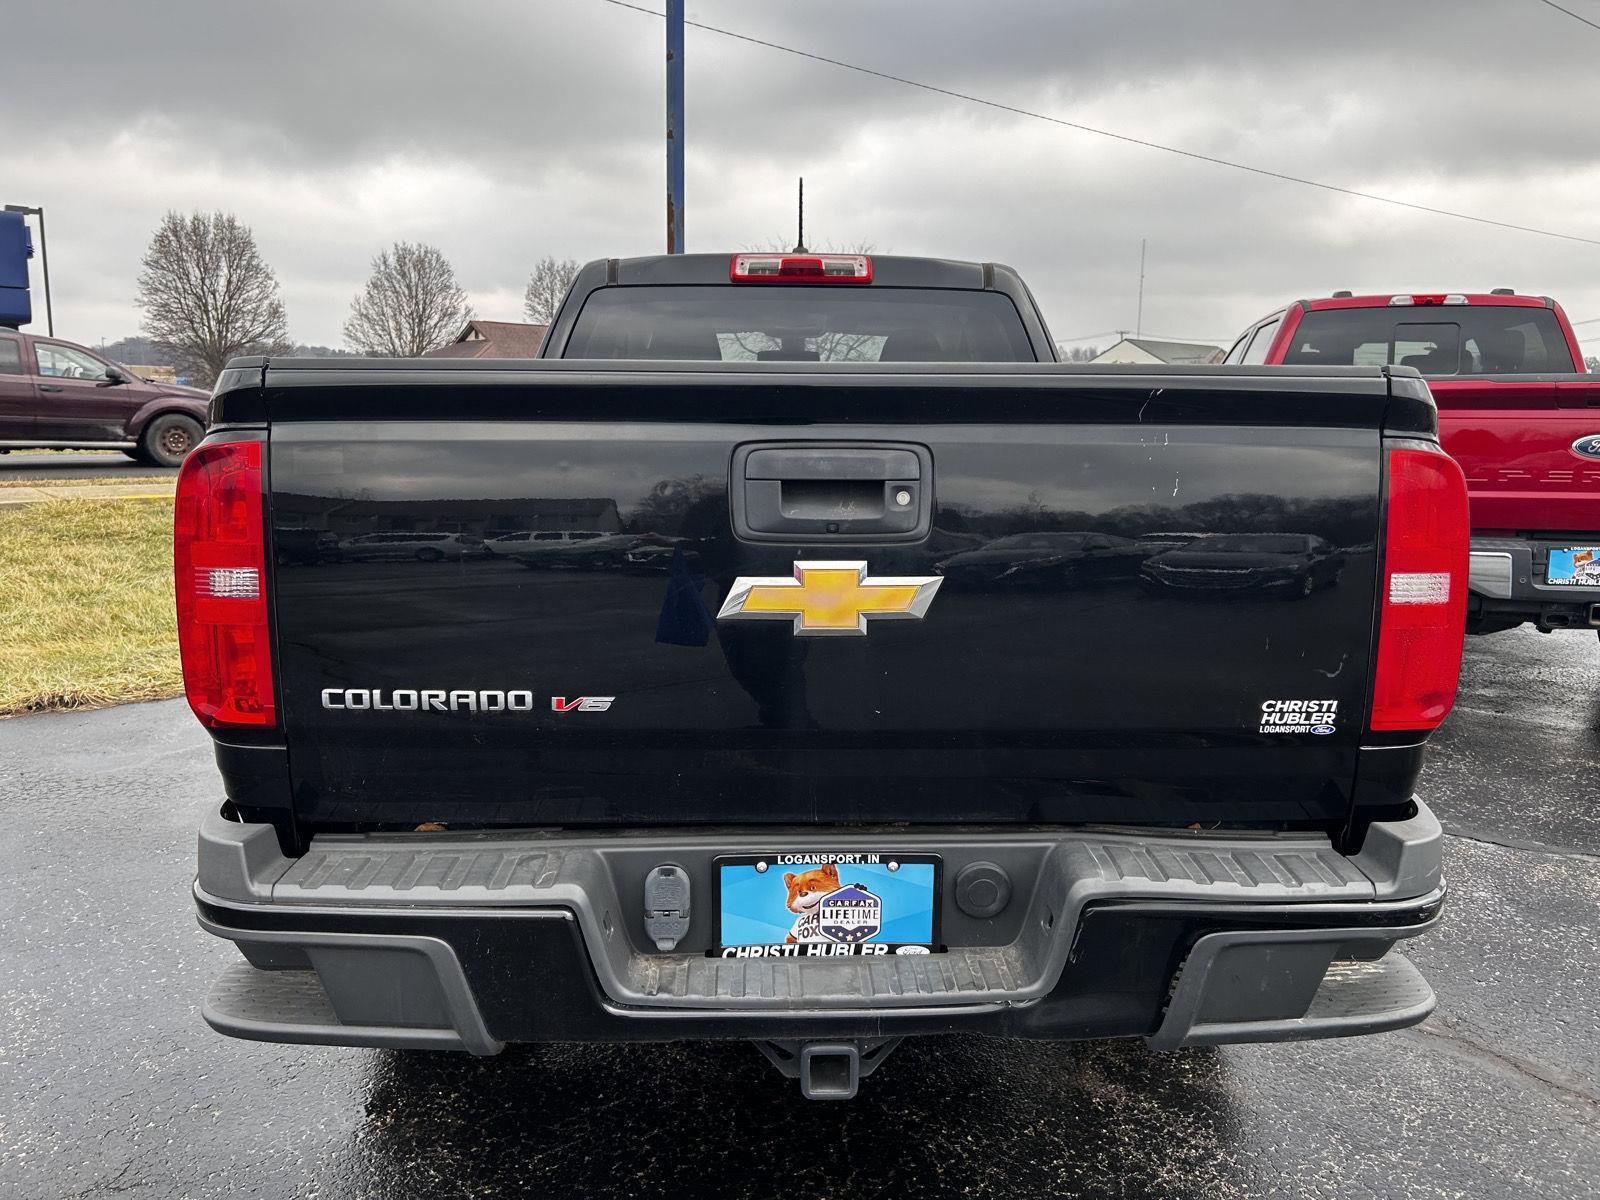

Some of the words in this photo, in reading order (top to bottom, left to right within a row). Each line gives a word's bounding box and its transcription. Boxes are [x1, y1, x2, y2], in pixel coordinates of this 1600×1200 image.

[321, 688, 533, 711] COLORADO
[551, 696, 616, 712] V6
[1261, 700, 1338, 712] CHRISTI
[1260, 712, 1336, 724] HUBLER
[1259, 725, 1310, 733] LOGANSPORT
[777, 854, 865, 865] LOGANSPORT,
[868, 854, 880, 864] IN
[829, 900, 874, 908] CARFAX
[822, 909, 879, 919] LIFETIME
[797, 925, 819, 939] FOX
[722, 945, 799, 958] CHRISTI
